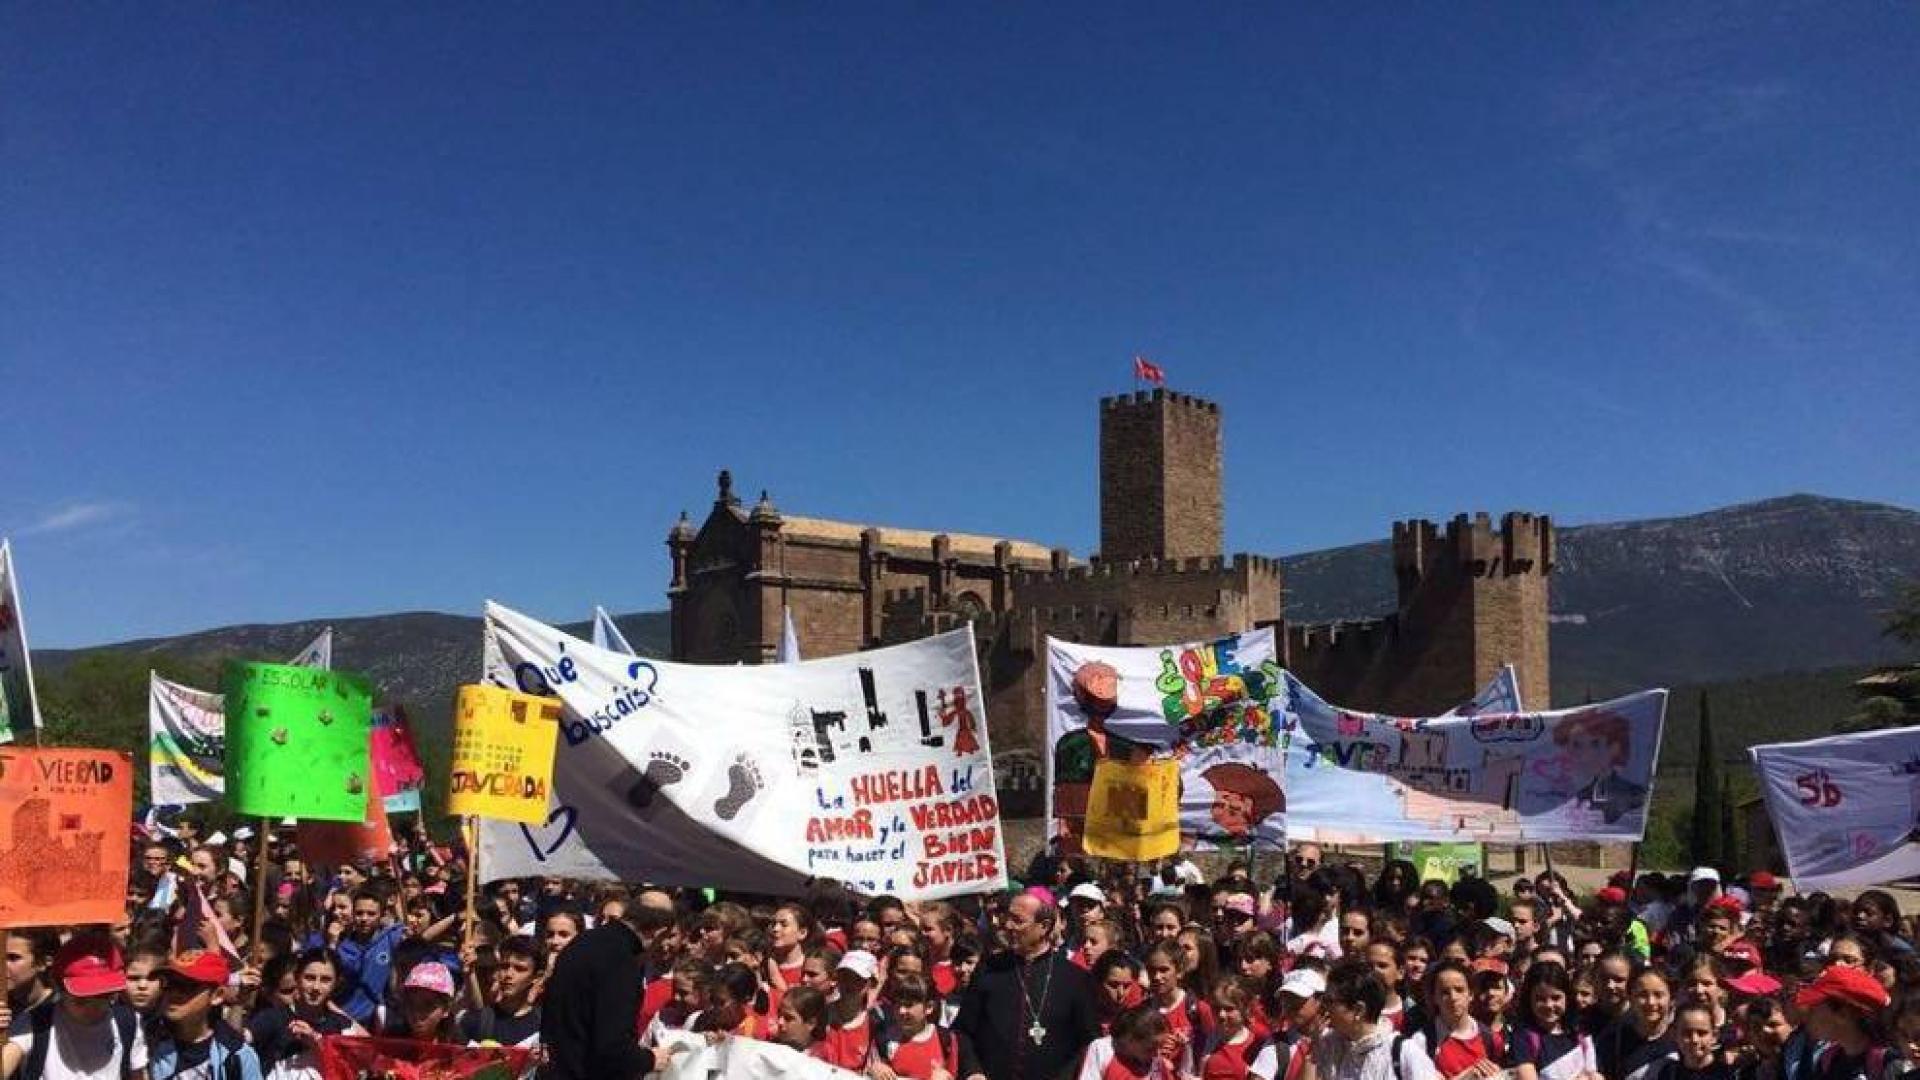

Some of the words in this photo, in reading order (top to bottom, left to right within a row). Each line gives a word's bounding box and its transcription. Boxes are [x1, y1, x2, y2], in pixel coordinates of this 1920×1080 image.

[851, 765, 944, 805] HUELLA
[951, 765, 973, 793] del
[806, 808, 874, 843] AMOR
[879, 827, 889, 845] y
[892, 815, 906, 833] la
[909, 794, 998, 831] VERDAD
[808, 848, 839, 868] para
[846, 845, 886, 862] hacer
[891, 841, 905, 860] el
[913, 854, 999, 889] JAVIER
